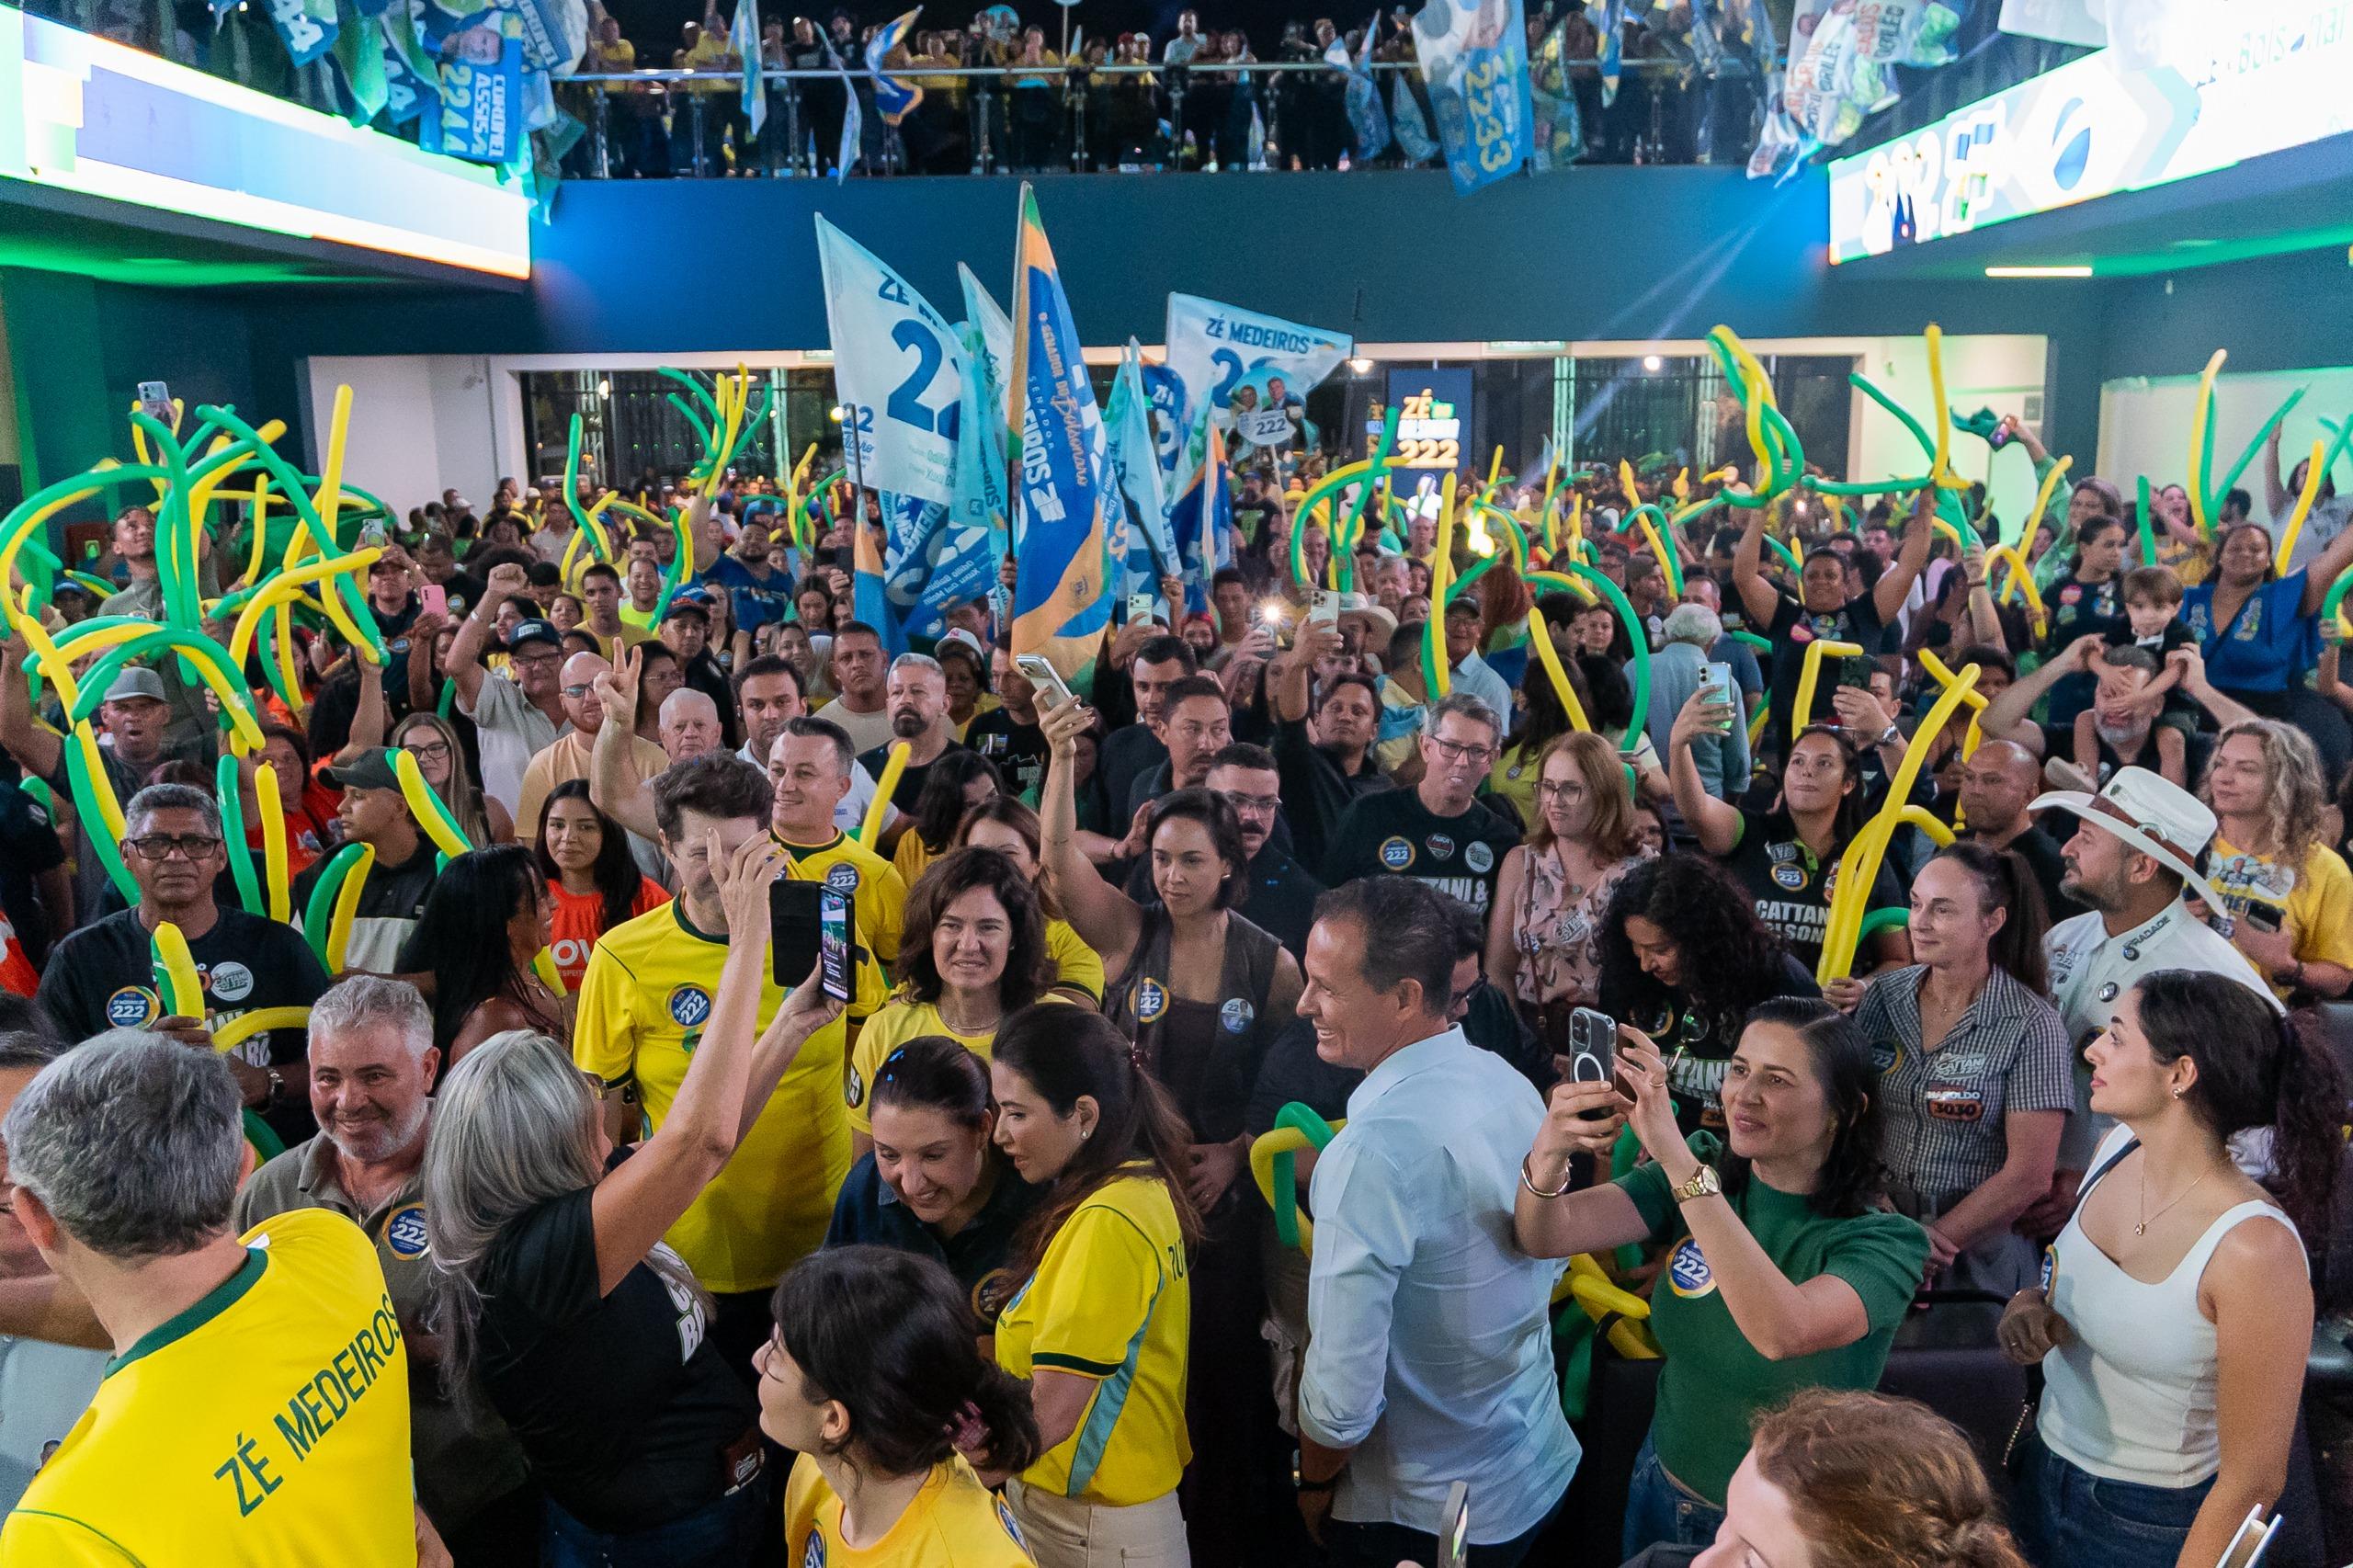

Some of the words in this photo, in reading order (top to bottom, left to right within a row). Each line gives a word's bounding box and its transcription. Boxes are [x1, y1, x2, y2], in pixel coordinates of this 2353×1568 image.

[1466, 62, 1512, 173] 2233
[1205, 313, 1226, 338] ZÉ
[1228, 321, 1310, 355] MEDEIROS
[1027, 375, 1054, 450] SENADOR
[1399, 388, 1434, 419] ZÉ
[1051, 394, 1088, 486] Bolsonaro
[1256, 417, 1287, 437] 222
[1397, 438, 1461, 469] 222
[1386, 850, 1408, 861] 222
[831, 874, 857, 887] 222
[1475, 880, 1489, 903] &
[1779, 873, 1802, 883] 222
[1756, 900, 1832, 927] CATTAN
[112, 1005, 145, 1018] 222
[680, 994, 708, 1025] 222
[1934, 1102, 1977, 1117] 3030
[391, 1222, 428, 1247] 222
[1673, 1254, 1711, 1285] 222
[213, 1433, 284, 1518] ZÉ
[273, 1292, 402, 1462] MEDEIROS
